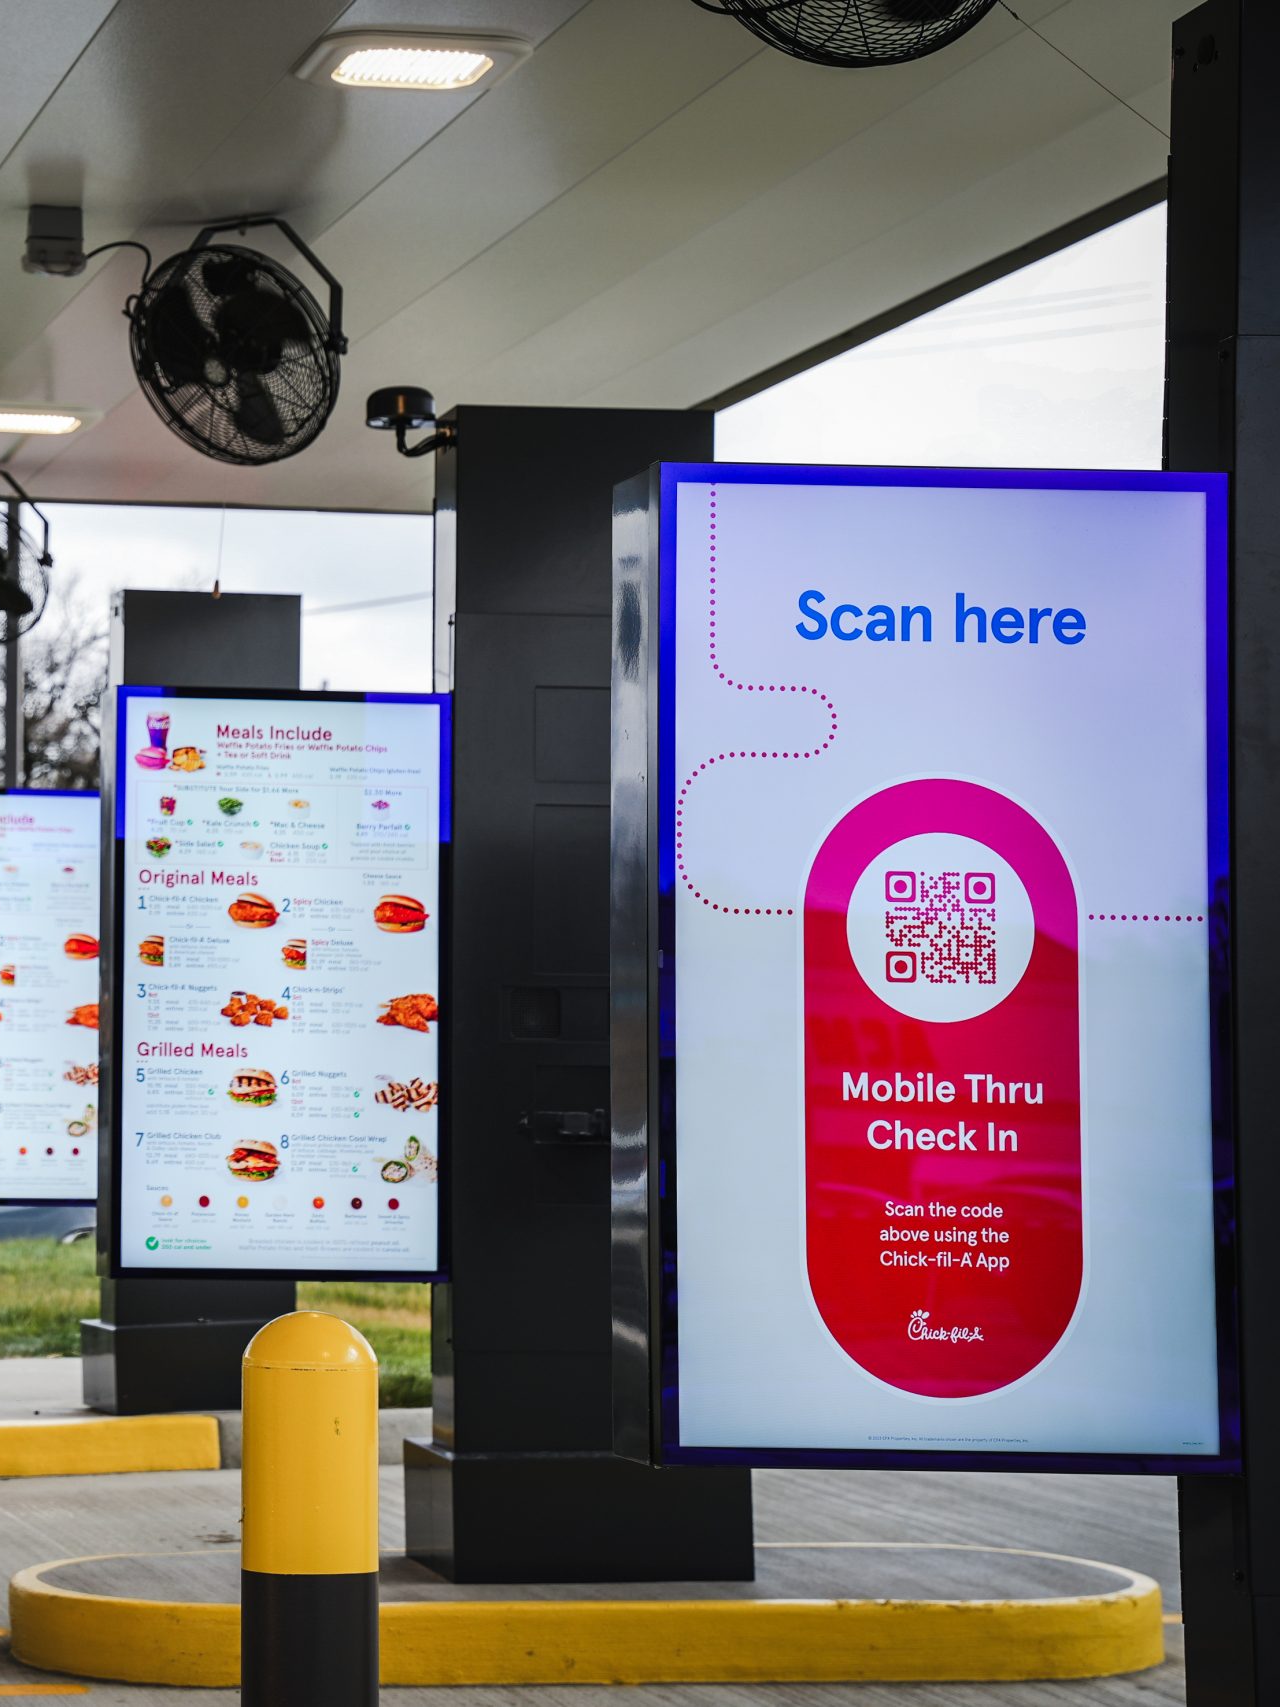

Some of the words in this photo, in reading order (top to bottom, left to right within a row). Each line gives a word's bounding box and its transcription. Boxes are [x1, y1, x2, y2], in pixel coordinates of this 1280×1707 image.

[795, 590, 932, 642] Scan
[955, 593, 1087, 645] here
[216, 725, 263, 739] Meals
[270, 726, 332, 741] Include
[217, 742, 243, 750] Waffle
[246, 742, 272, 750] Potato
[274, 743, 294, 751] Fries
[308, 744, 334, 752] Waffle
[365, 745, 388, 753] Chips
[139, 869, 205, 888] Original
[211, 871, 259, 886] Meals
[137, 895, 147, 910] 1
[282, 898, 291, 913] 2
[137, 983, 147, 998] 3
[281, 986, 291, 1000] 4
[137, 1042, 194, 1057] Grilled
[201, 1043, 248, 1058] Meals
[136, 1068, 145, 1083] 5
[280, 1070, 290, 1085] 6
[842, 1071, 956, 1104] Mobile
[964, 1074, 1045, 1105] Thru
[135, 1132, 144, 1147] 7
[280, 1134, 289, 1149] 8
[866, 1120, 977, 1152] Check
[987, 1122, 1019, 1152] In
[884, 1201, 924, 1218] Scan
[928, 1201, 957, 1218] the
[960, 1202, 1003, 1219] code
[879, 1226, 929, 1243] above
[934, 1227, 978, 1246] using
[981, 1227, 1009, 1244] the
[975, 1252, 1010, 1273] App
